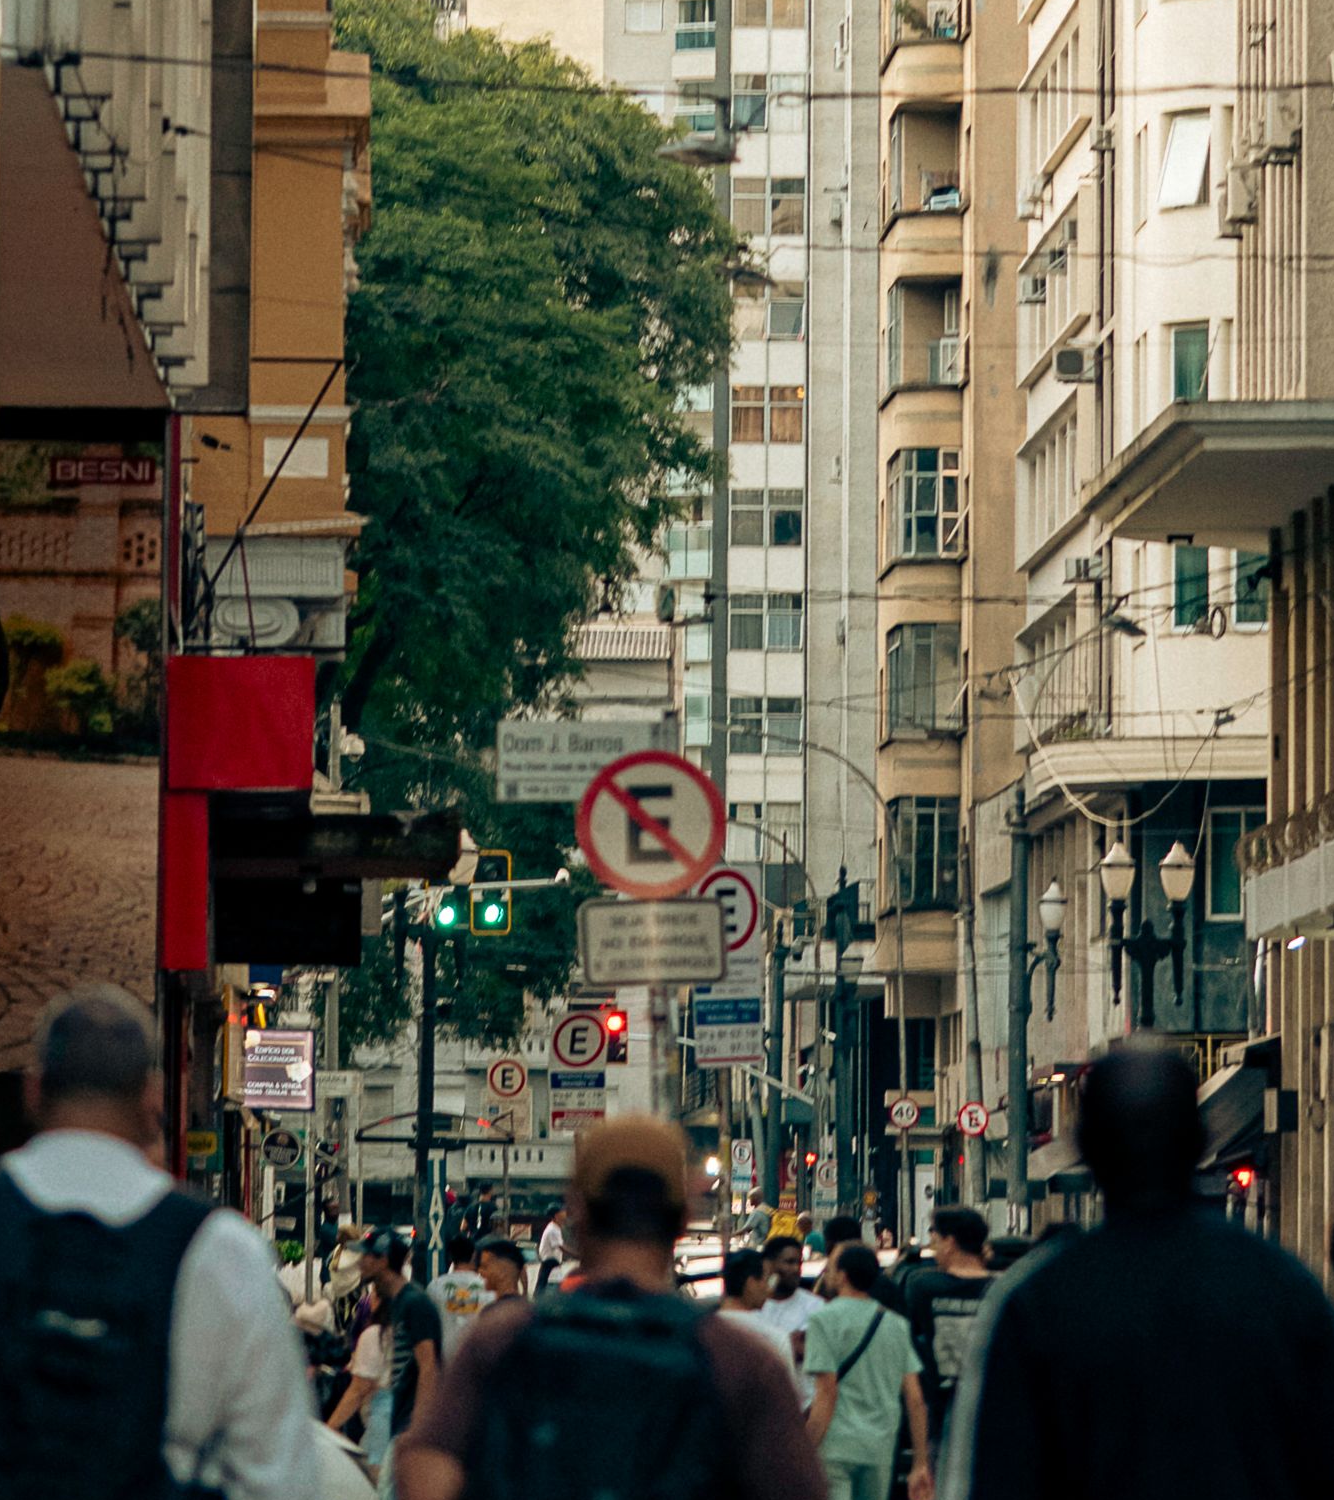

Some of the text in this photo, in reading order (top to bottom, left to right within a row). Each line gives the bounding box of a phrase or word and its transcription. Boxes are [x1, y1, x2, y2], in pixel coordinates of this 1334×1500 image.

[55, 460, 151, 481] BESNI
[503, 732, 544, 753] Dom
[568, 732, 624, 753] Barros
[627, 784, 674, 865] E
[569, 1025, 589, 1056] E
[500, 1067, 514, 1090] E
[894, 1105, 915, 1120] 40
